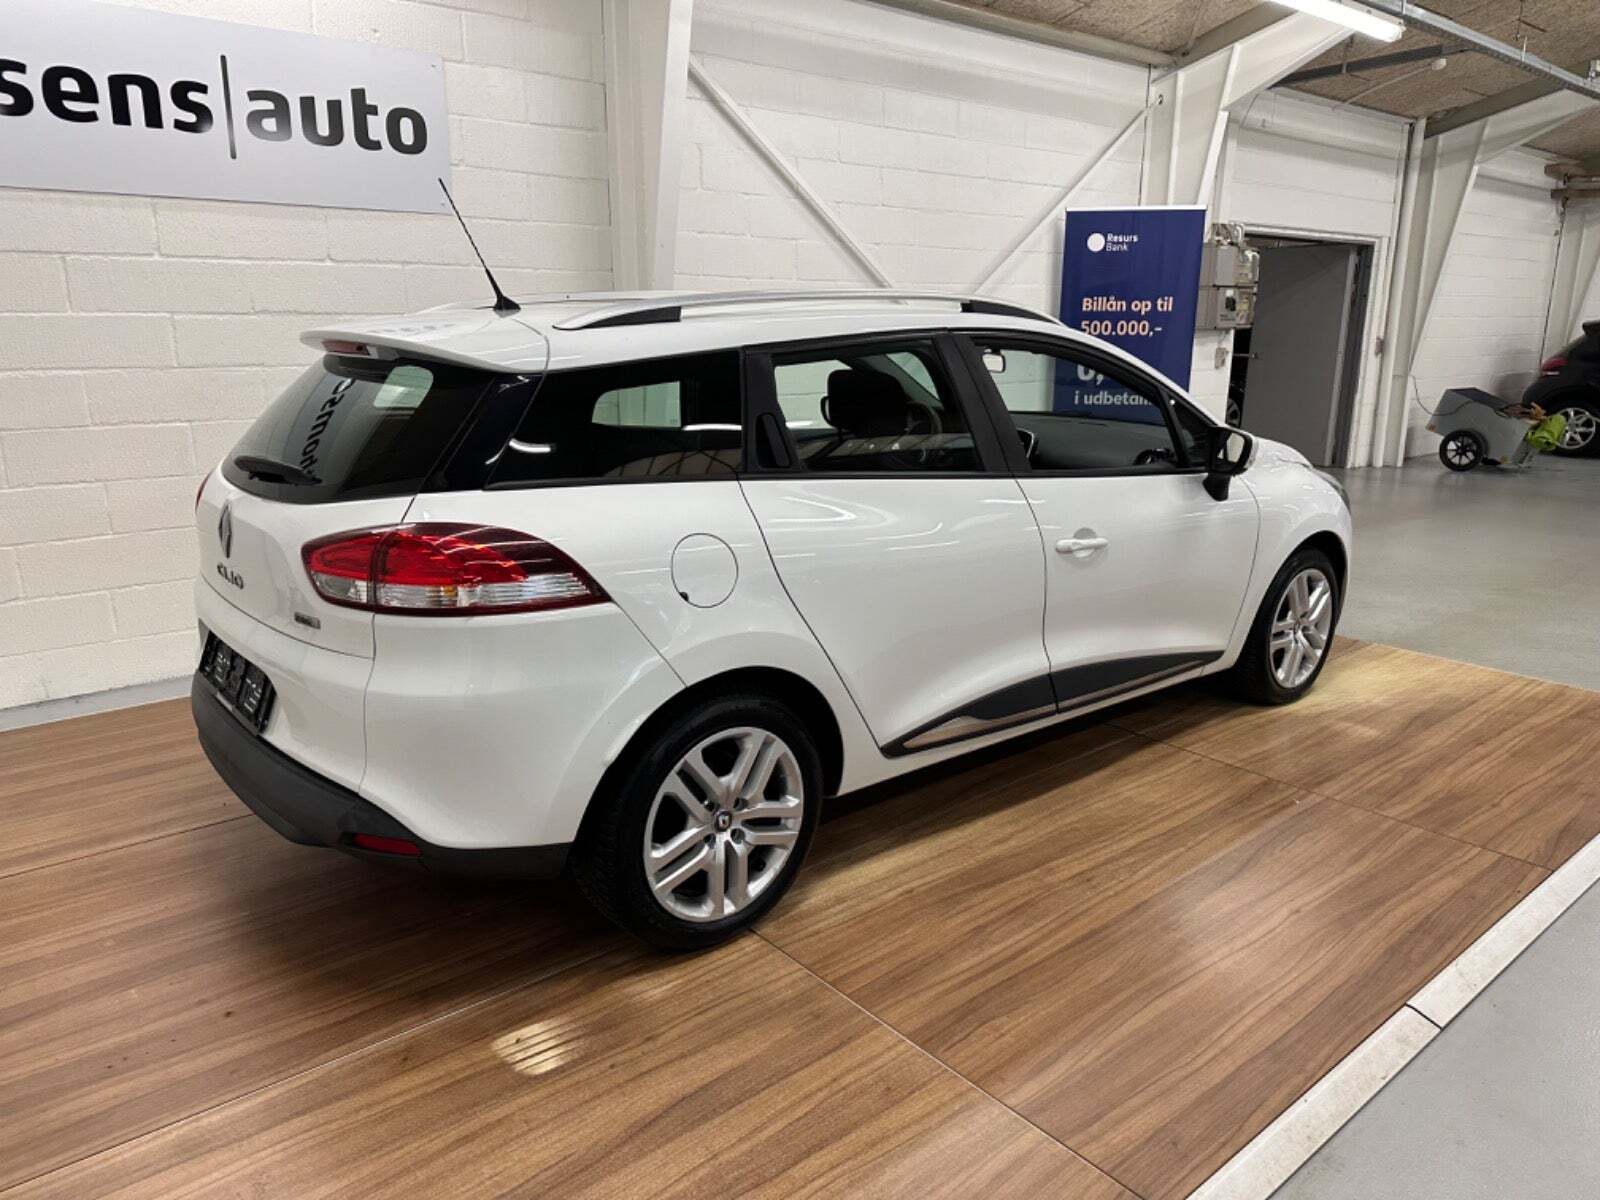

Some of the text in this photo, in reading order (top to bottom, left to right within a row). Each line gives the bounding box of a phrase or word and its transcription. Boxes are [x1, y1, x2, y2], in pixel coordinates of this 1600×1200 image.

[246, 88, 428, 155] auto
[1107, 232, 1138, 242] Resurs
[1106, 242, 1128, 251] Bank
[1082, 295, 1173, 315] Billån op til
[1081, 320, 1162, 337] 500.000,-
[1074, 390, 1080, 405] i
[216, 561, 244, 590] CLIO
